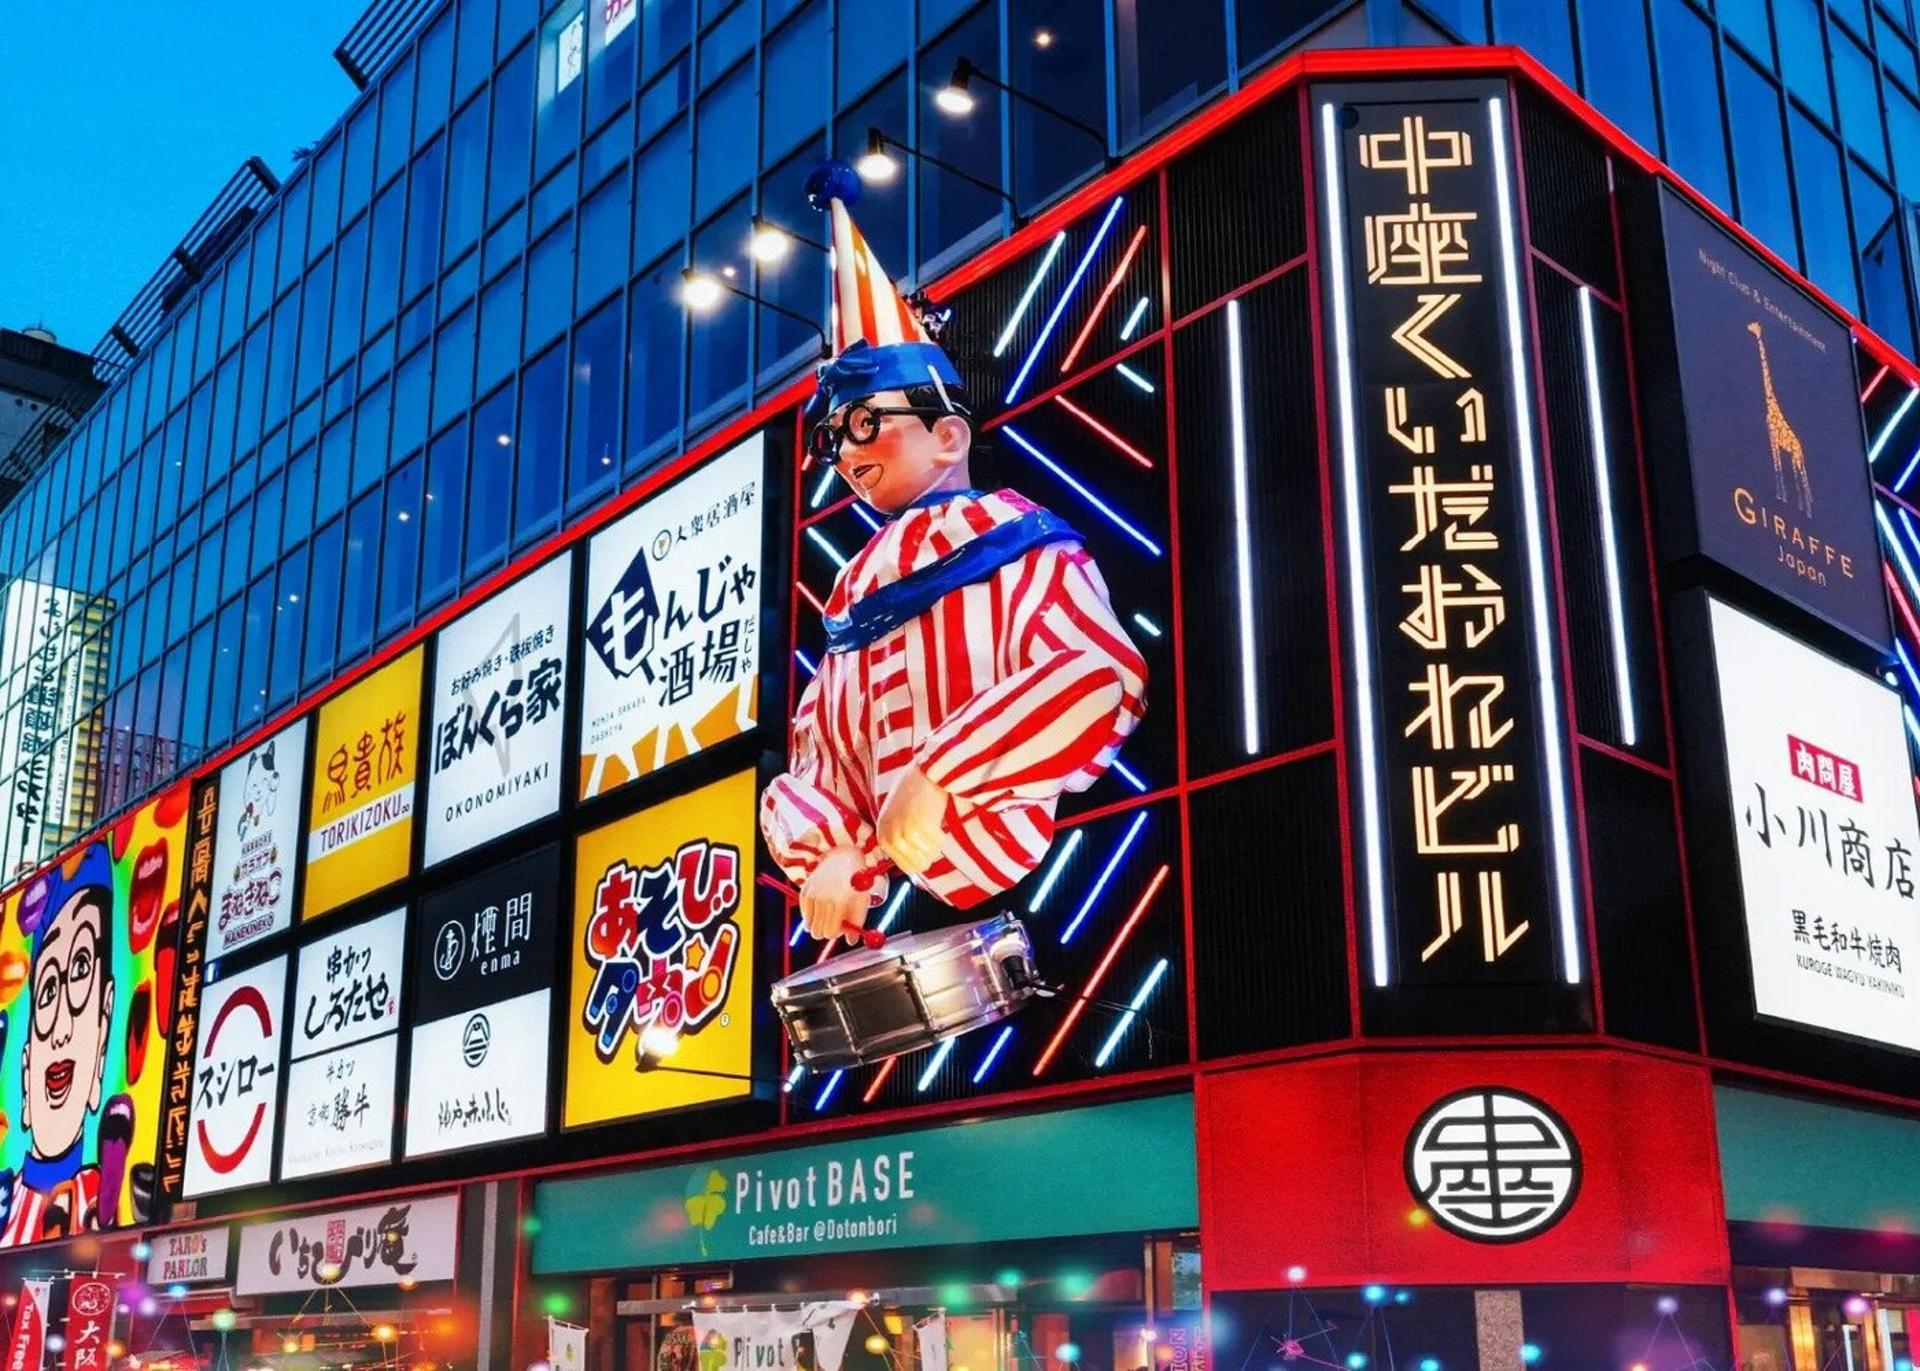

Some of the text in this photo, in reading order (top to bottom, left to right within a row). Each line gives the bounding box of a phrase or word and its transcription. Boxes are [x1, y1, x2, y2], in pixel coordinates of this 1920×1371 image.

[1777, 543, 1827, 587] Japan
[658, 619, 741, 707] 酒場
[434, 657, 562, 774] ぼんくら家
[445, 761, 550, 823] OKONOMIYAKI
[1795, 741, 1858, 800] 肉問屋
[320, 793, 402, 853] TORIKIZOKU
[1745, 781, 1916, 901] 小川商店
[588, 842, 737, 957] あそび
[326, 945, 372, 984] 串カツ
[480, 950, 521, 976] enma
[1791, 908, 1902, 974] 黒毛和牛焼肉
[304, 971, 390, 1040] しろたや
[1796, 953, 1906, 999] KUROGE WAGYU YAKINIKU
[194, 1054, 275, 1112] スシロー
[735, 1151, 915, 1215] Pivot BASE
[748, 1213, 898, 1247] Cafe&Bar @Dotonbori
[163, 1257, 208, 1280] PARLOR
[11, 1302, 35, 1371] Tax Free
[73, 1320, 101, 1370] 大阪
[733, 1336, 785, 1368] Pivot
